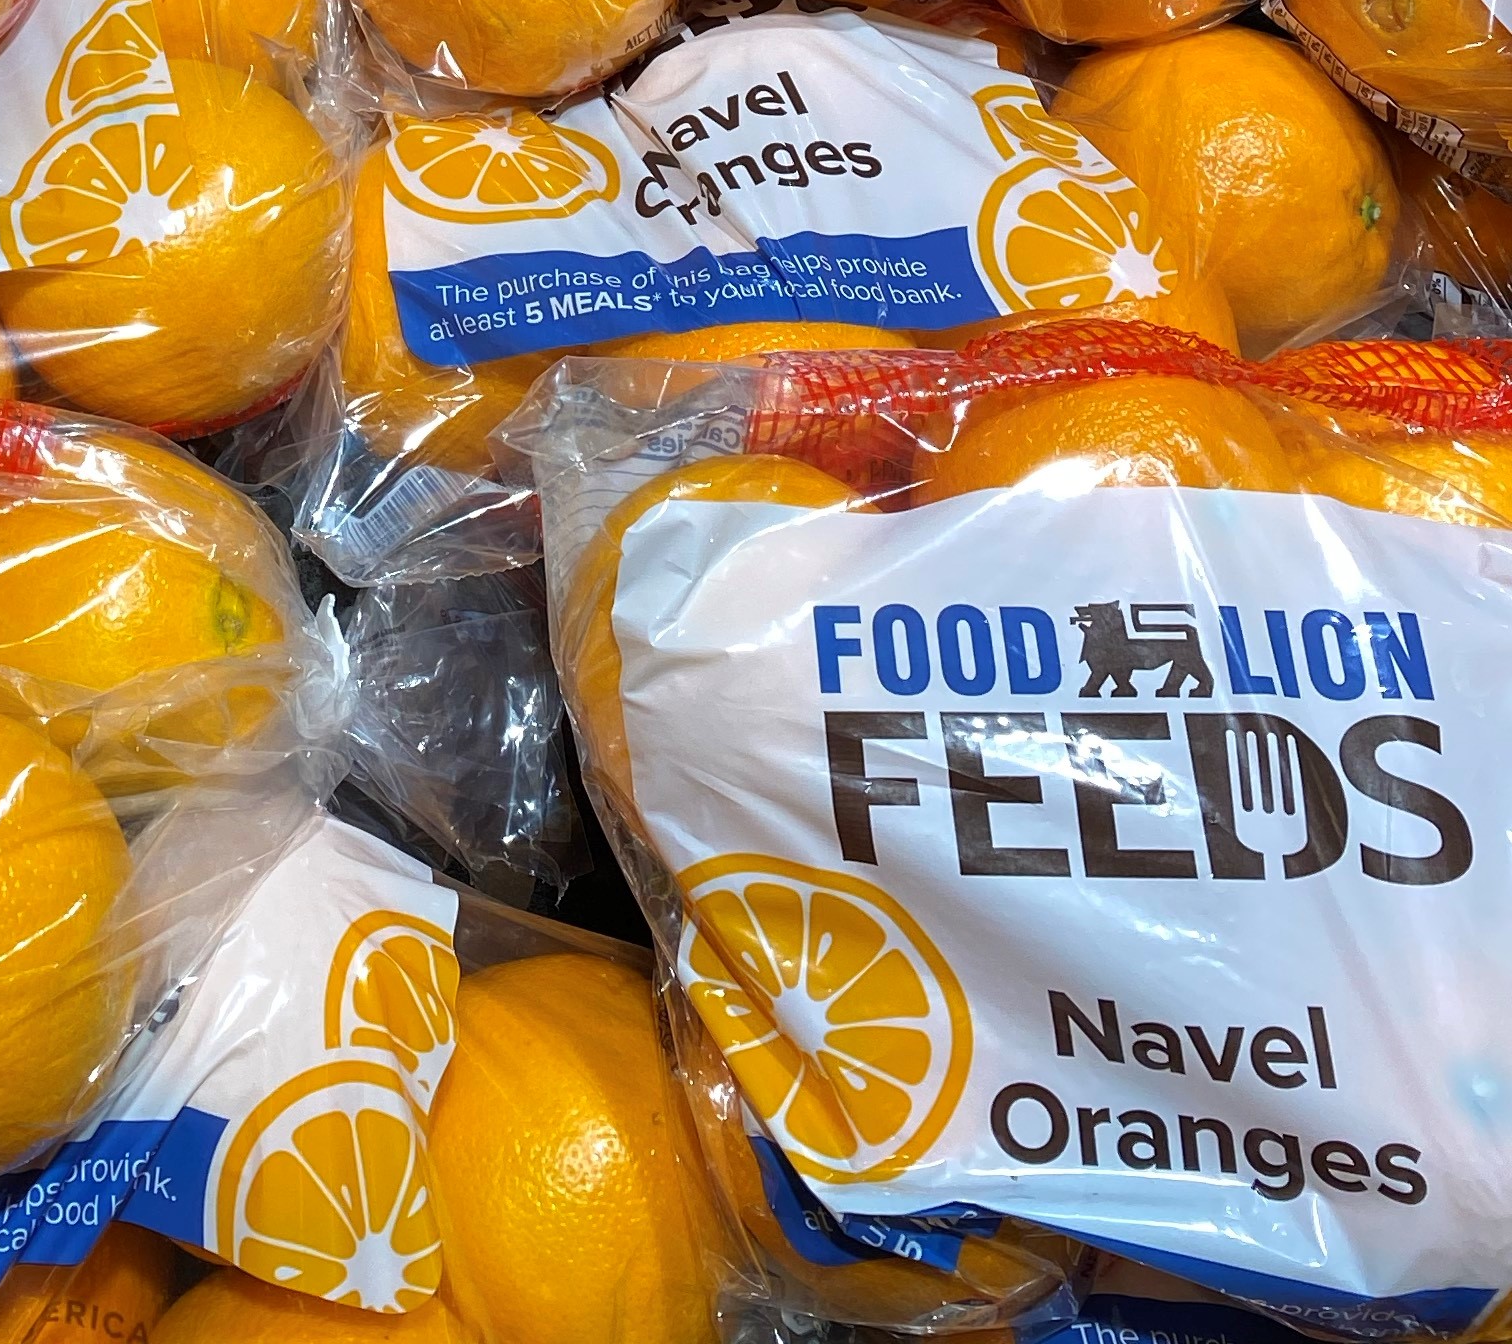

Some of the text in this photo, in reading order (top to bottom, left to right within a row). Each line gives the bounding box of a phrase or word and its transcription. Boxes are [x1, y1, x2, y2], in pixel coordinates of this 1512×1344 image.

[496, 254, 927, 305] purchase provide
[888, 281, 962, 305] bank.
[813, 603, 1434, 700] FOOD LION
[823, 710, 1473, 885] FEEDS
[1047, 989, 1338, 1090] Navel
[989, 1082, 1428, 1204] Oranges
